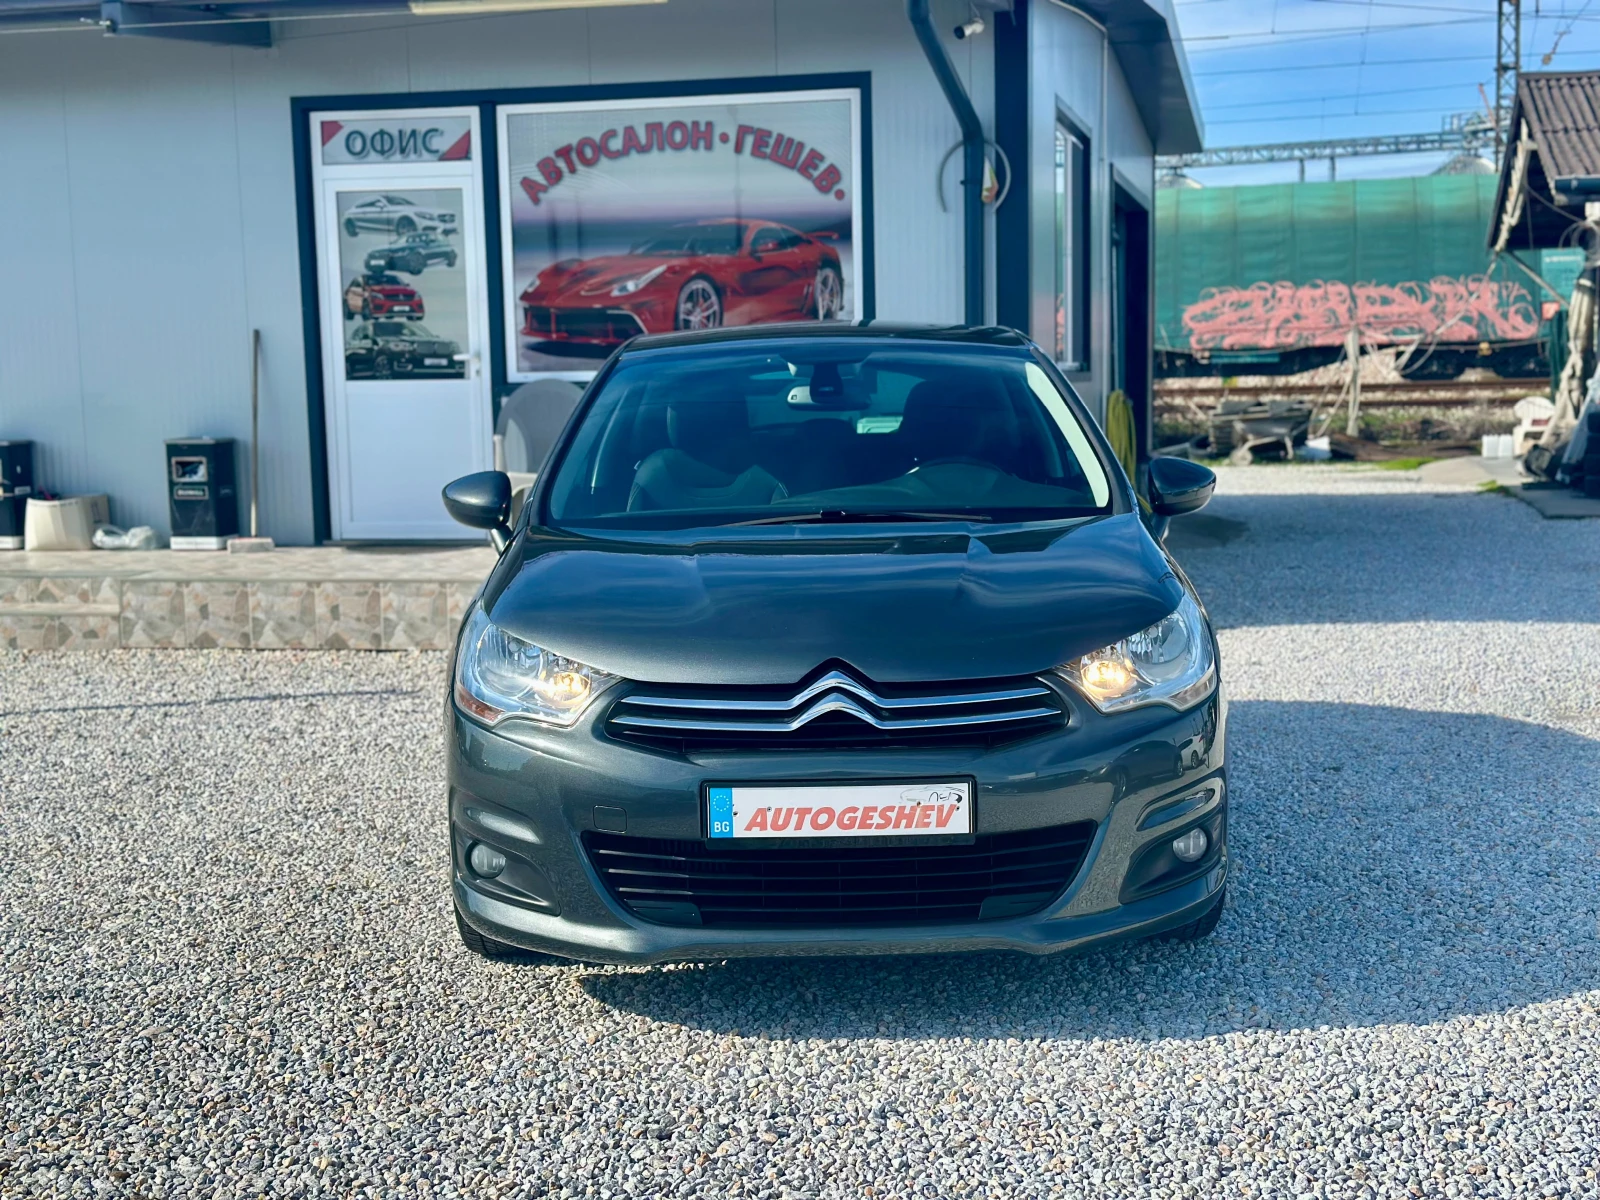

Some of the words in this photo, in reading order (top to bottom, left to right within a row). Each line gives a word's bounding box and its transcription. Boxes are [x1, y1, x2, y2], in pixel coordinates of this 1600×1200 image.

[344, 127, 443, 158] ОФИС
[519, 120, 714, 205] АВТОСАЛОН
[714, 821, 730, 833] BG
[744, 804, 957, 831] AUTOGESHEV
